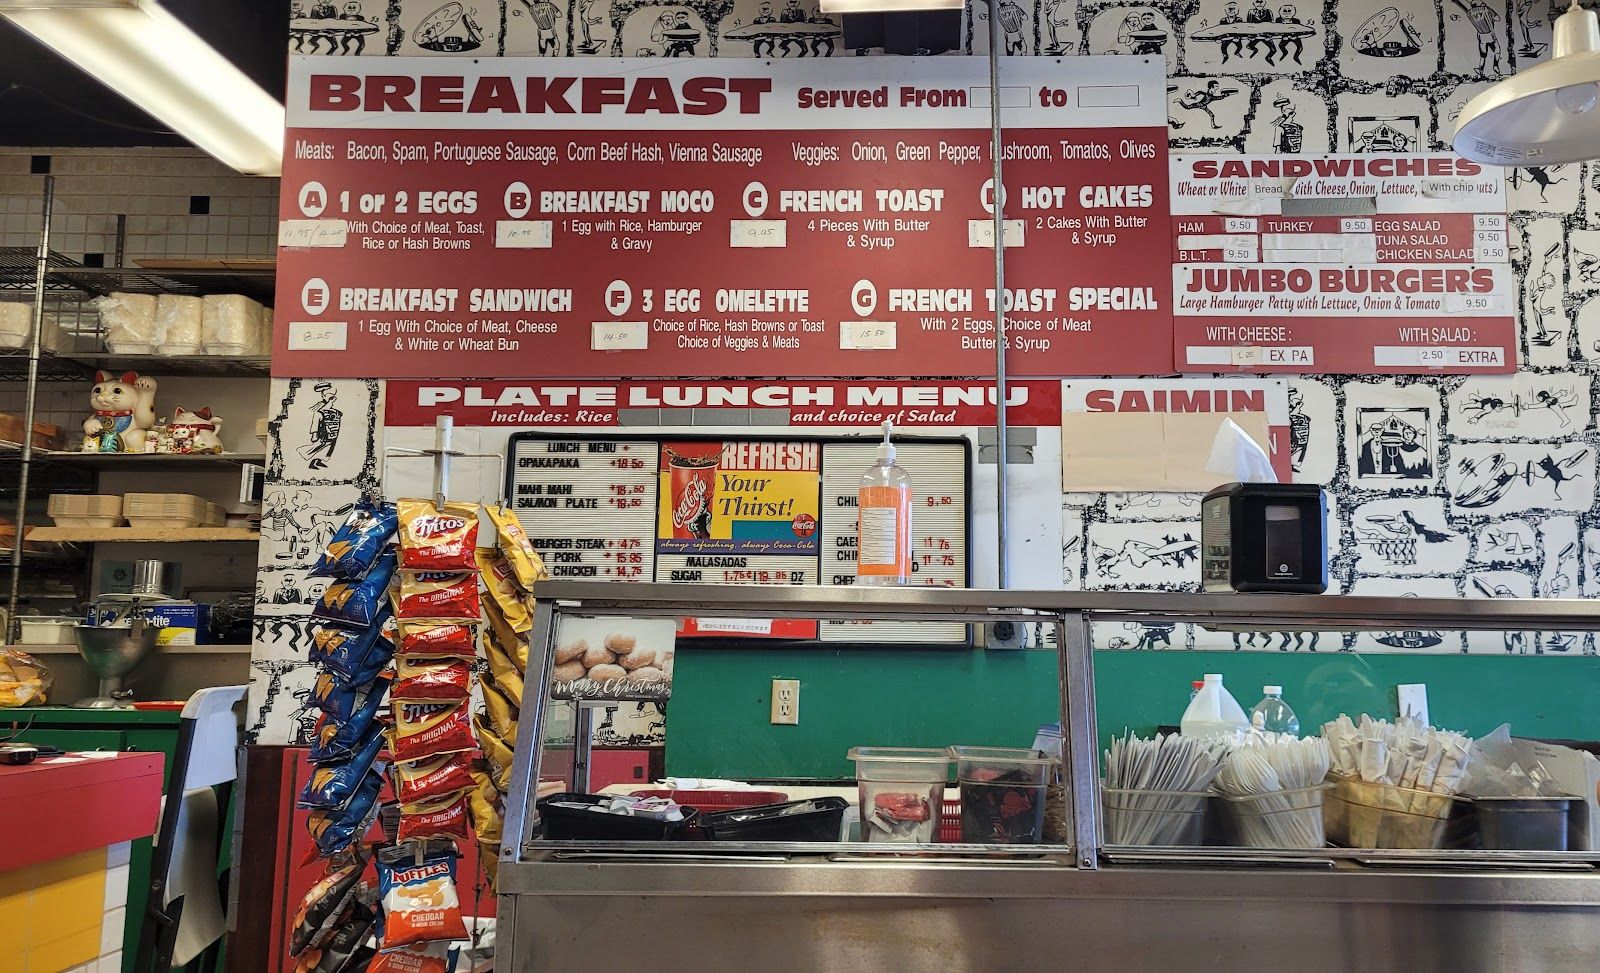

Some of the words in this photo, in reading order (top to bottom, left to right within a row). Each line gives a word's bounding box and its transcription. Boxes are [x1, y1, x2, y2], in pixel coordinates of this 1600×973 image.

[309, 74, 772, 115] BREAKFAST
[798, 86, 888, 109] Served
[901, 87, 966, 107] From
[1039, 86, 1067, 107] to
[295, 141, 334, 159] Meats:
[347, 142, 387, 162] Bacon,
[393, 142, 429, 162] Spam,
[434, 142, 501, 164] Portuguese
[506, 142, 559, 164] Sausage,
[567, 143, 595, 161] Corn
[601, 142, 628, 161] Beef
[631, 143, 664, 163] Hash,
[668, 143, 707, 162] Vienna
[711, 143, 762, 165] Sausage
[792, 142, 839, 166] Veggies:
[852, 142, 888, 162] Onion,
[896, 142, 930, 161] Green
[939, 142, 981, 165] Pepper,
[1060, 141, 1111, 162] Tomatos,
[1120, 141, 1155, 159] Olives
[1192, 158, 1482, 178] SANDWICHES
[1021, 187, 1066, 208] HOT
[1080, 185, 1153, 208] CAKES
[1177, 181, 1207, 196] Wheat
[1208, 185, 1218, 196] or
[1220, 181, 1247, 196] White
[1255, 184, 1283, 194] Bread
[1381, 180, 1418, 197] Lettuce,
[1429, 181, 1451, 192] With
[1453, 181, 1474, 194] chip
[304, 191, 322, 209] A
[340, 191, 349, 212] 1
[360, 193, 386, 213] or
[395, 192, 408, 212] 2
[418, 191, 477, 213] EGGS
[509, 192, 527, 210] B
[540, 190, 649, 212] BREAKFAST
[661, 190, 714, 212] MOCO
[780, 189, 862, 212] FRENCH
[876, 189, 944, 211] TOAST
[345, 220, 370, 234] With
[372, 221, 408, 234] Choice
[410, 221, 420, 234] of
[423, 221, 452, 236] Meat,
[455, 221, 485, 236] Toast,
[1179, 222, 1204, 232] HAM
[1230, 221, 1251, 230] 9.50
[1268, 222, 1314, 232] TURKEY
[1345, 221, 1366, 230] 9.50
[1375, 221, 1400, 231] EGG
[1402, 221, 1441, 231] SALAD
[1479, 218, 1500, 227] 9.50
[1376, 235, 1408, 245] TUNA
[1410, 235, 1448, 245] SALAD
[1478, 233, 1499, 242] 9.50
[1180, 251, 1210, 261] B.L.T.
[1228, 249, 1249, 259] 9.50
[1377, 249, 1433, 260] CHICKEN
[1436, 249, 1474, 260] SALAD
[1483, 248, 1503, 258] 9.50
[1187, 269, 1312, 293] JUMBO
[1320, 269, 1494, 293] BURGERS
[308, 289, 324, 306] E
[339, 288, 458, 311] BREAKFAST
[469, 288, 572, 312] SANDWICH
[611, 289, 625, 307] F
[642, 289, 653, 311] 3
[664, 289, 700, 311] EGG
[715, 289, 809, 312] OMELETTE
[858, 290, 872, 306] G
[889, 289, 972, 311] FRENCH
[986, 288, 1056, 311] TOAST
[1069, 287, 1157, 311] SPECIAL
[1180, 296, 1207, 310] Large
[1210, 295, 1263, 311] Hamburger
[1269, 296, 1294, 311] Patty
[1297, 295, 1318, 309] with
[1321, 295, 1360, 312] Lettuce,
[1364, 296, 1392, 310] Onion
[1394, 298, 1402, 309] &
[1406, 296, 1440, 310] Tomato
[1466, 299, 1487, 308] 9.50
[359, 320, 364, 333] 1
[368, 320, 391, 336] Egg
[395, 320, 420, 334] With
[423, 320, 463, 334] Choice
[466, 320, 477, 334] of
[481, 320, 512, 335] Meat,
[516, 320, 558, 334] Cheese
[1207, 328, 1236, 341] WITH
[1399, 328, 1428, 341] WITH
[1270, 351, 1285, 362] EX
[1293, 350, 1308, 362] PA
[1422, 350, 1443, 360] 2.50
[1459, 351, 1498, 362] EXTRA
[418, 386, 616, 406] PLATE
[629, 386, 834, 406] LUNCH
[847, 386, 1029, 406] MENU
[1086, 390, 1264, 412] SAIMIN
[490, 410, 569, 423] Includes:
[575, 410, 612, 423] Rice
[792, 410, 823, 422] and
[828, 410, 882, 422] choice
[887, 410, 904, 425] of
[907, 409, 956, 423] Salad
[548, 443, 580, 452] LUNCH
[588, 443, 616, 452] MENU
[519, 458, 579, 468] OPAKAPAKA
[722, 443, 817, 471] REFRESH
[518, 485, 542, 494] MAHI
[548, 484, 572, 494] MAHI
[721, 475, 771, 492] Your
[518, 498, 557, 508] SALMON
[566, 498, 598, 508] PLATE
[720, 496, 794, 516] Thirst!
[837, 496, 859, 506] CHIL
[415, 516, 465, 537] Fritos
[576, 539, 605, 548] STEAK
[661, 540, 689, 552] always
[692, 540, 737, 552] refreshing,
[741, 541, 769, 552] always
[773, 541, 814, 549] Coca-Cola
[554, 552, 582, 562] PORK
[686, 557, 746, 567] MALASADAS
[553, 566, 597, 576] CHICKEN
[671, 571, 702, 580] SUGAR
[791, 571, 804, 582] DZ
[431, 586, 464, 601] ORIGINAL
[603, 676, 669, 697] Christmas
[421, 720, 456, 742] ORIGINAL
[432, 806, 462, 822] ORIGINAL
[392, 862, 449, 883] RUFFLES
[412, 913, 444, 922] CHEDDAR
